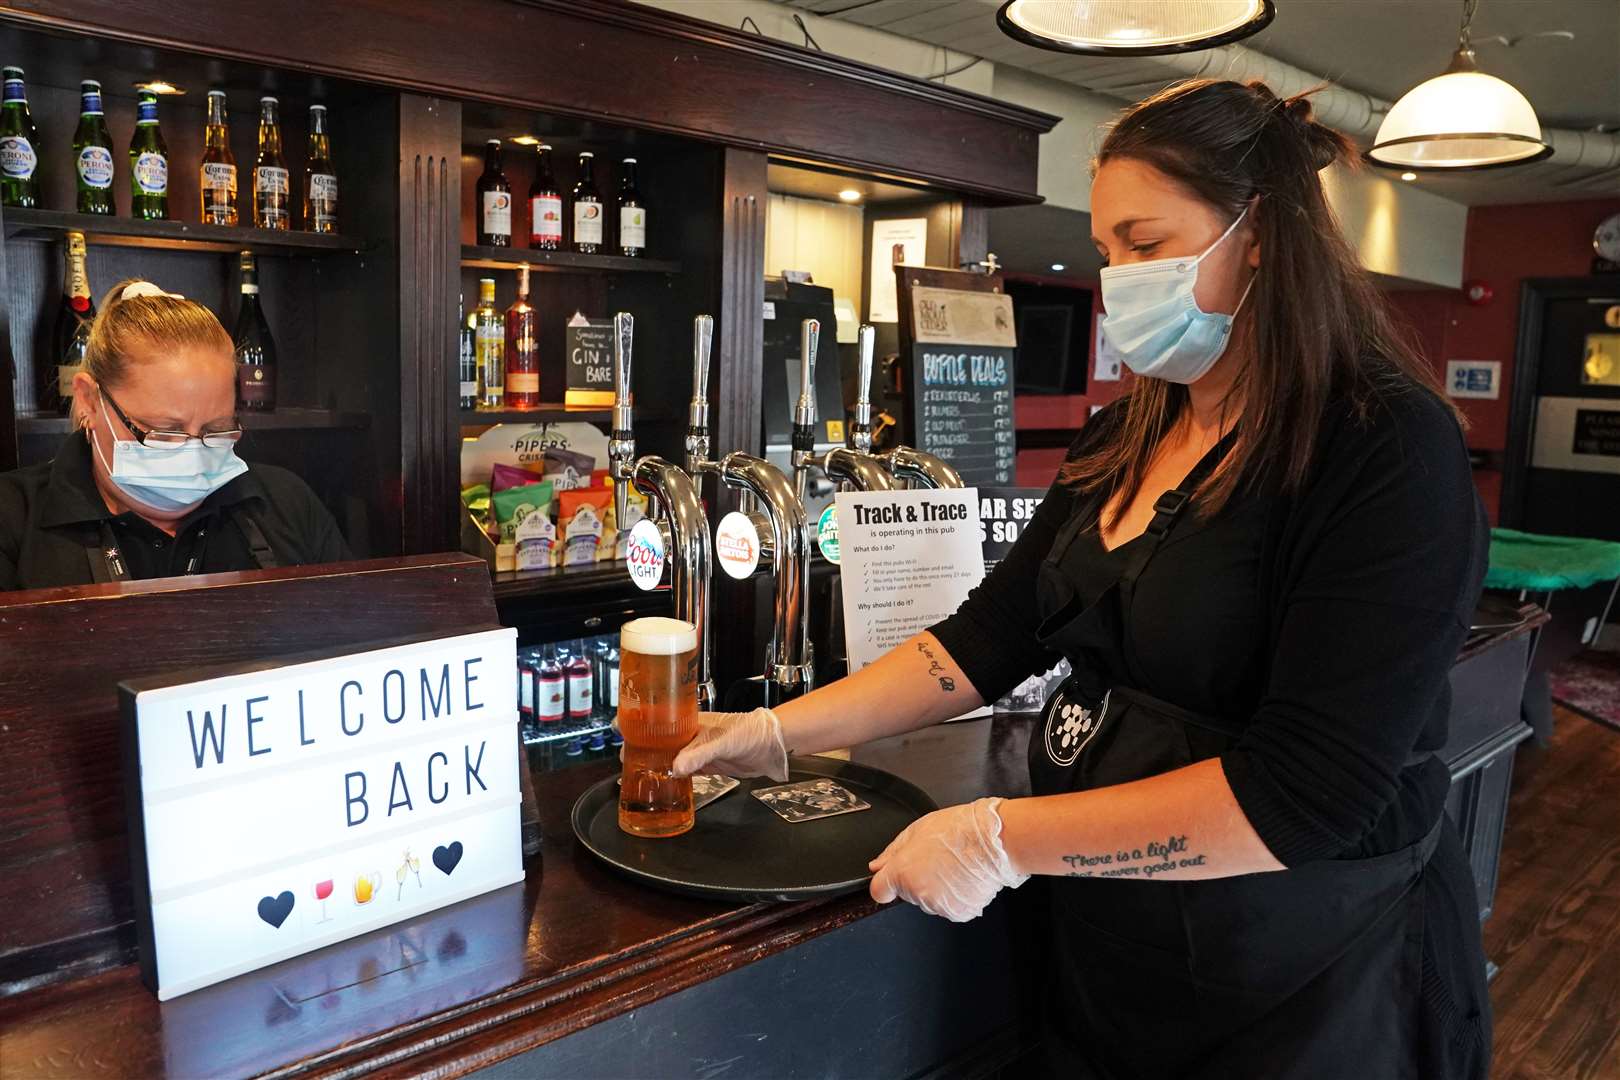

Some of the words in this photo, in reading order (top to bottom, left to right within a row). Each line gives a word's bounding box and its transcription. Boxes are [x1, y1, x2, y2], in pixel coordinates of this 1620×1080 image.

[572, 347, 600, 365] GIN
[586, 365, 612, 382] BARE
[923, 353, 967, 385] BOTTLE
[971, 354, 1008, 386] DEALS
[515, 439, 568, 452] PIPERS
[853, 503, 903, 525] Track
[906, 505, 918, 522] &
[921, 501, 967, 521] Trace
[980, 498, 1007, 519] AR
[879, 528, 915, 539] operating
[917, 527, 923, 535] in
[925, 526, 939, 535] this
[941, 525, 955, 536] pub
[992, 521, 1018, 543] SO
[853, 545, 870, 553] What
[871, 544, 879, 552] do
[857, 602, 871, 610] Why
[187, 656, 485, 769] WELCOME
[344, 741, 488, 828] BACK
[1062, 854, 1113, 869] There
[1116, 850, 1130, 863] is
[1131, 849, 1144, 860] a
[1147, 834, 1189, 861] light
[1100, 867, 1140, 877] never
[1143, 860, 1177, 878] goes
[1179, 854, 1207, 868] out
